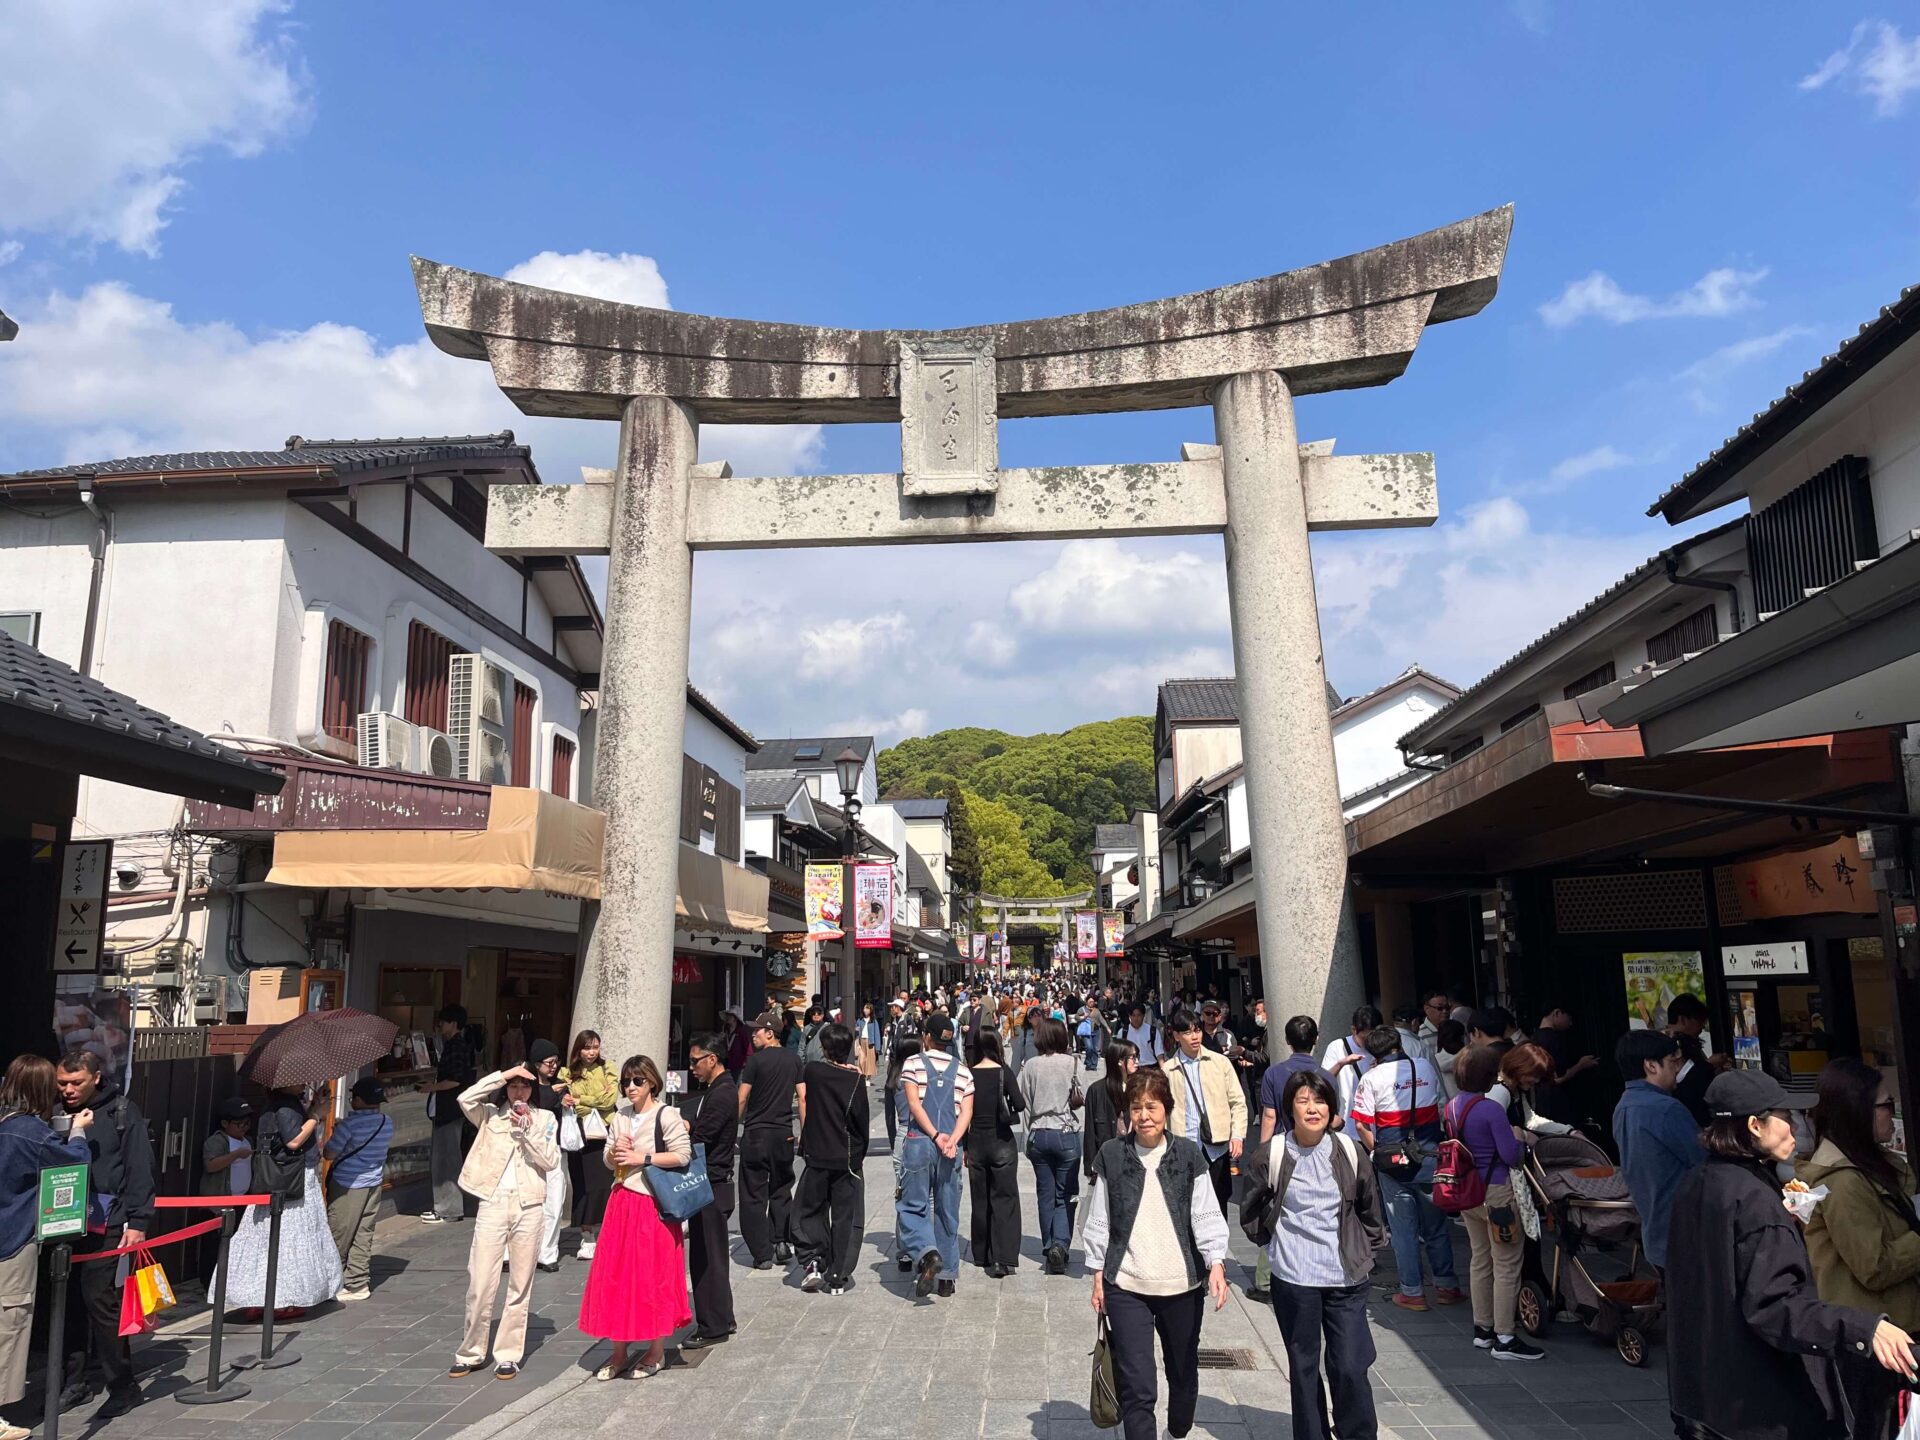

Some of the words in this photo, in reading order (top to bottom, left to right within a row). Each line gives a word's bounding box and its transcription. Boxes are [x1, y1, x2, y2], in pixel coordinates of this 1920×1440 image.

[877, 878, 888, 900] 若冲
[58, 927, 99, 937] Restaurant
[673, 1173, 707, 1192] COACH
